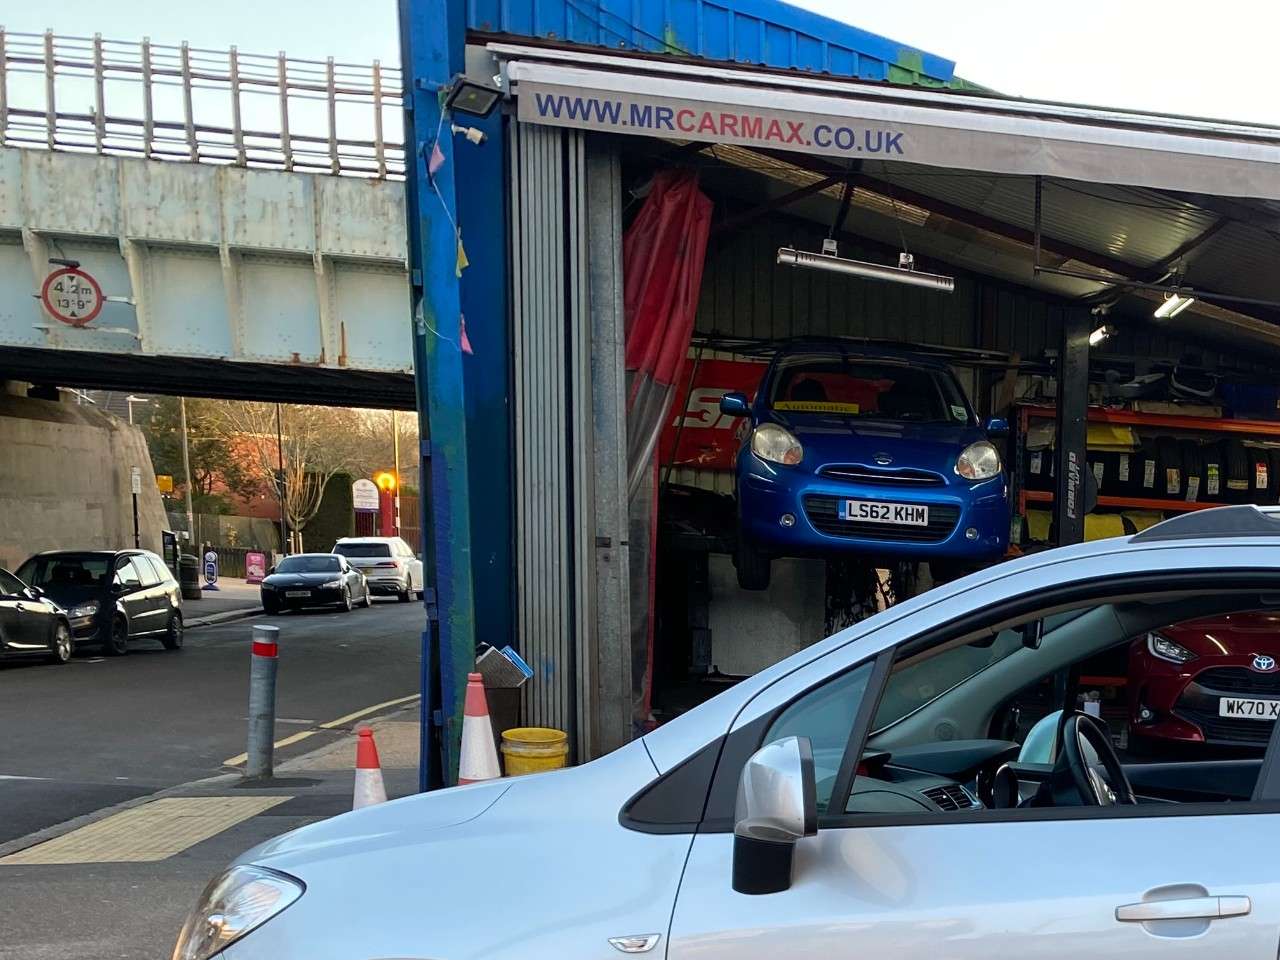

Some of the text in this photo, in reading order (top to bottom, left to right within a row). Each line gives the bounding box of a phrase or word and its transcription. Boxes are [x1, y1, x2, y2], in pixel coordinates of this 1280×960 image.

[535, 92, 904, 154] WWW.MRCARMAX.CO.UK
[848, 502, 925, 523] LS62 KHM
[1226, 700, 1265, 715] WK70
